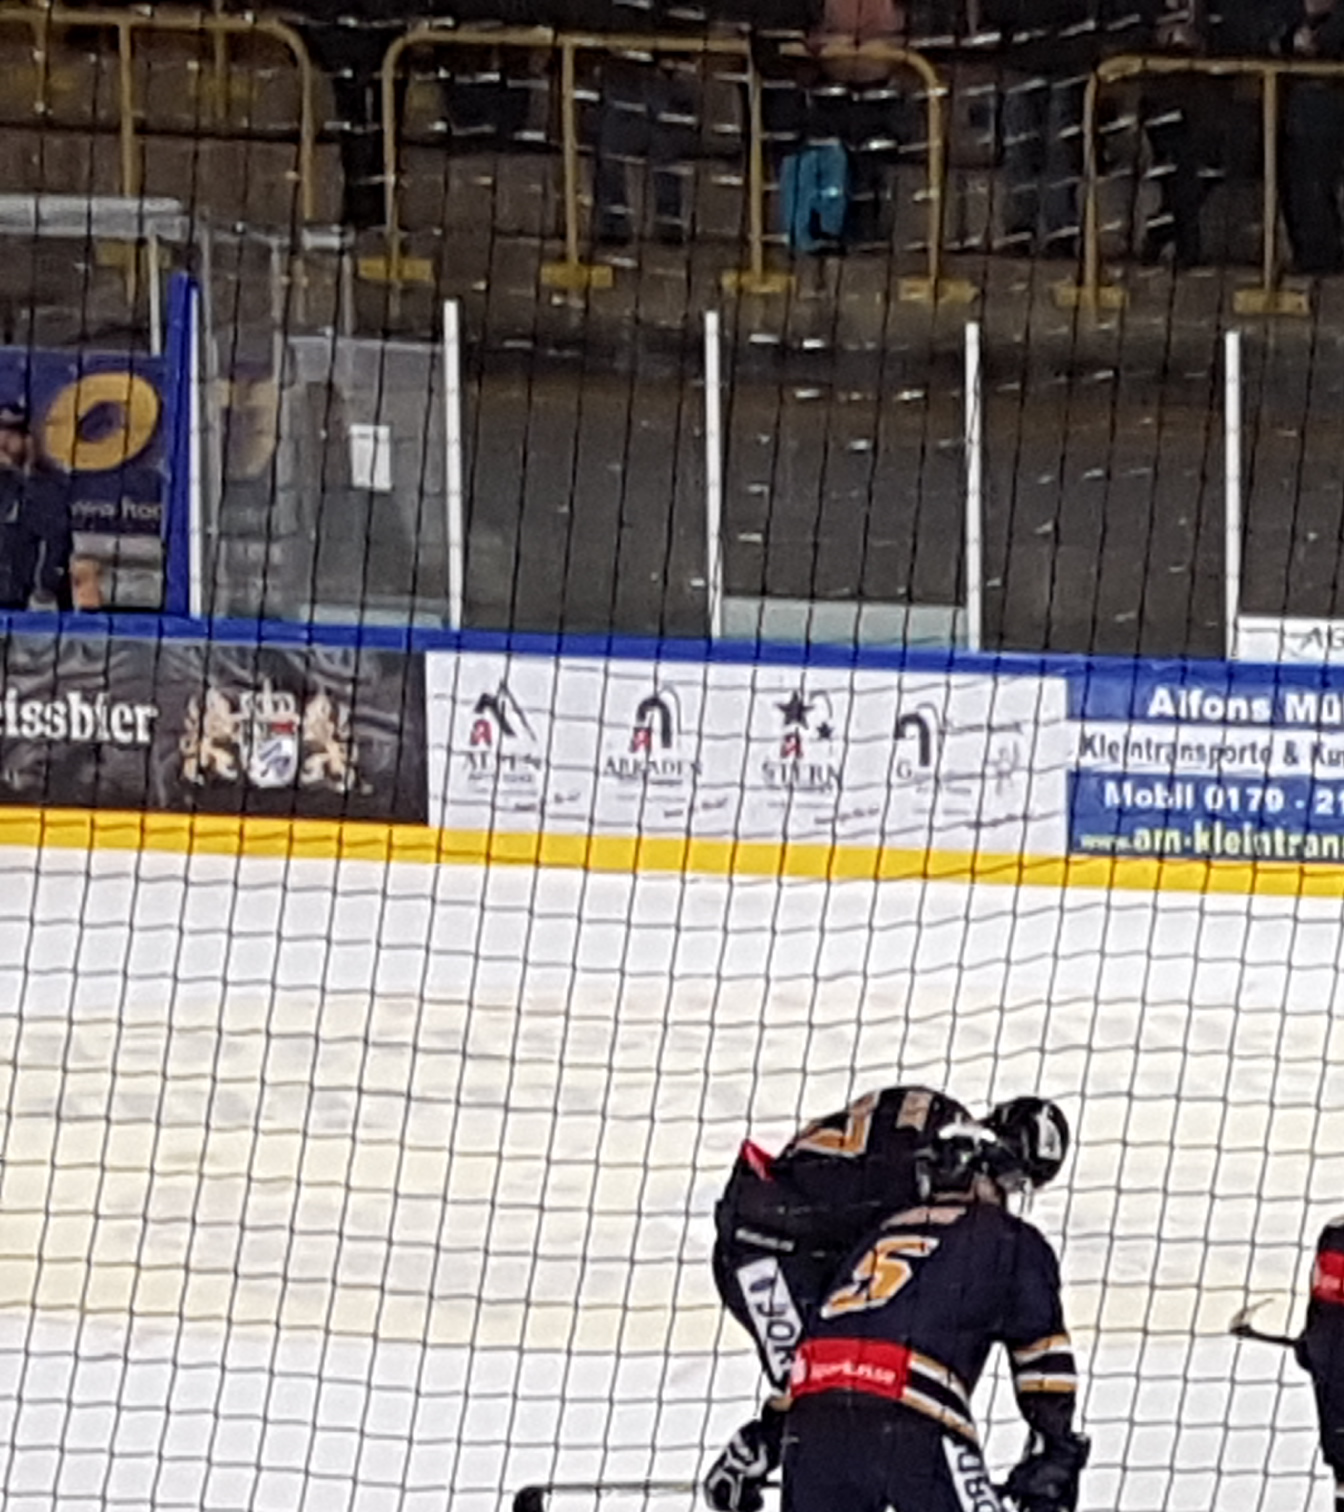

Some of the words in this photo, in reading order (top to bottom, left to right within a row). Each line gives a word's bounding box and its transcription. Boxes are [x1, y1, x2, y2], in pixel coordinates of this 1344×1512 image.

[1147, 685, 1272, 723] Alfons
[1079, 732, 1273, 771] Kleintransporte
[1104, 780, 1194, 810] Mobil
